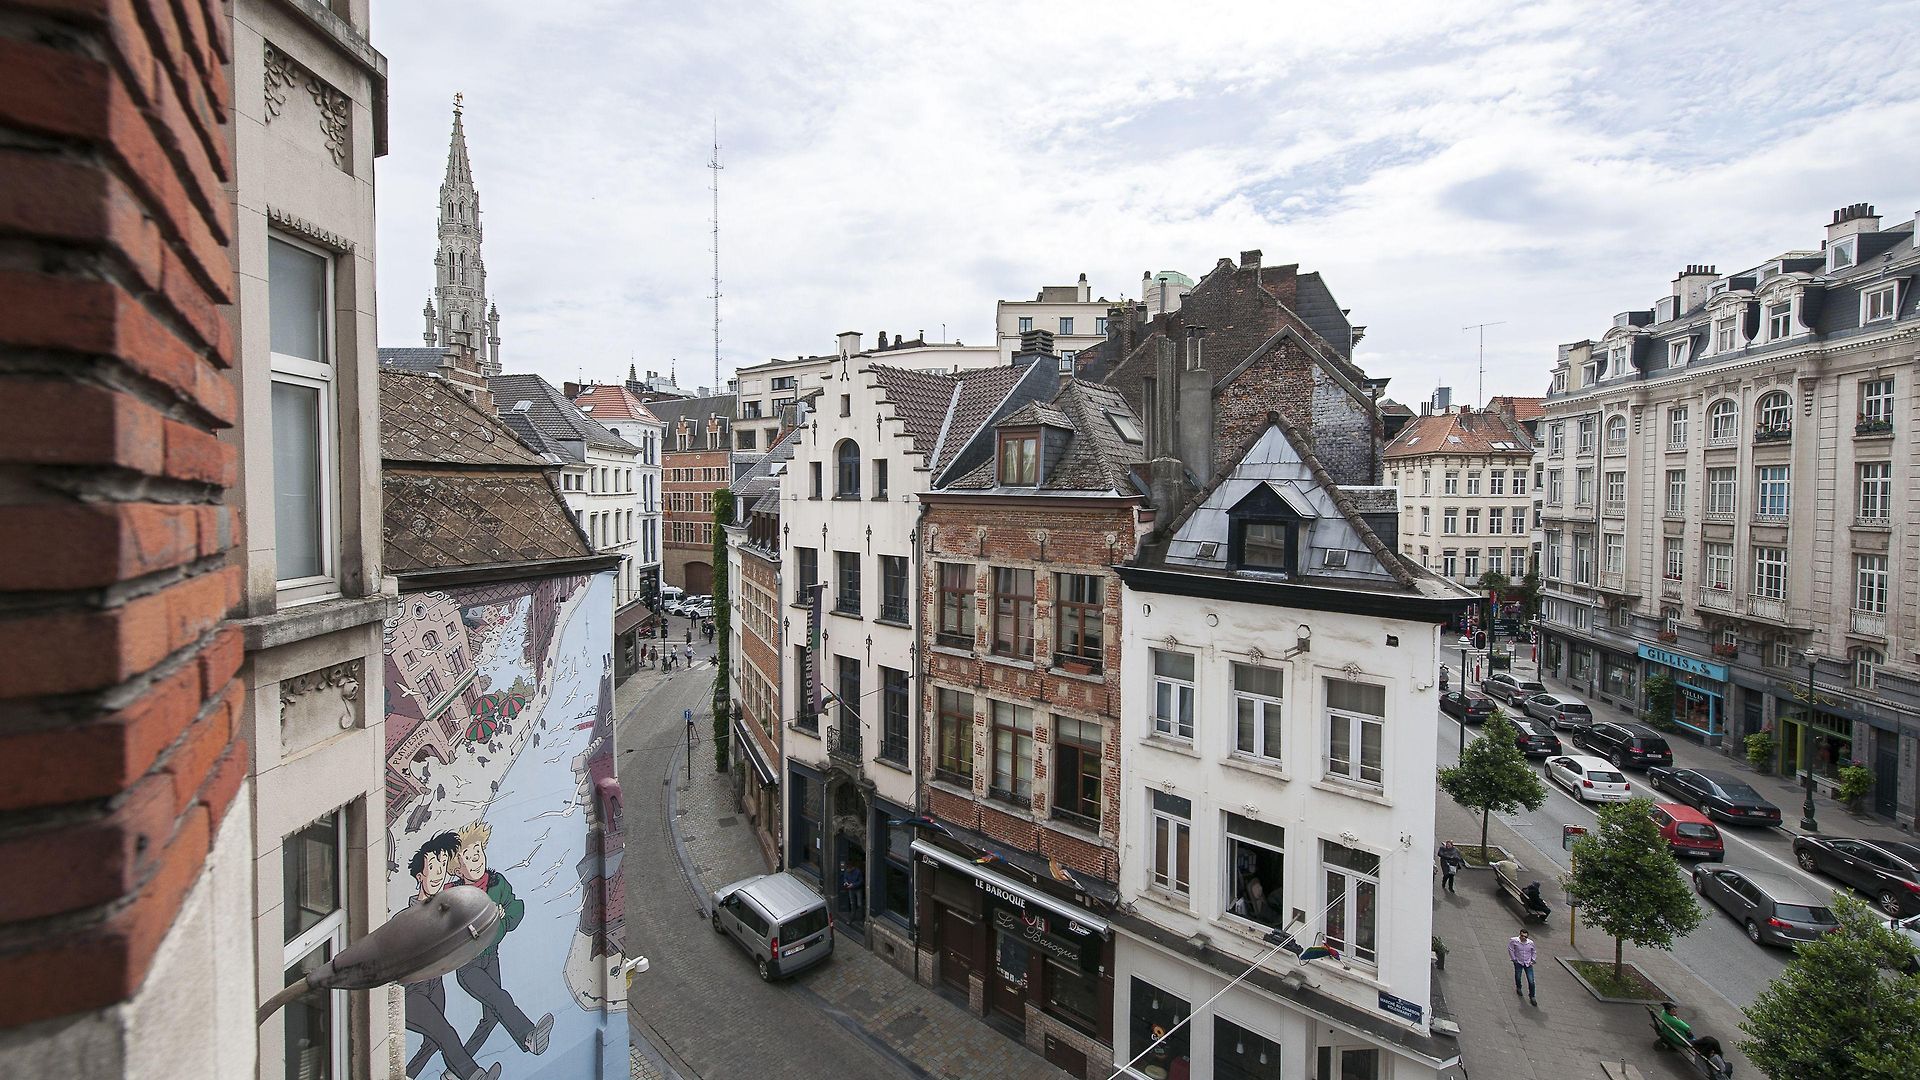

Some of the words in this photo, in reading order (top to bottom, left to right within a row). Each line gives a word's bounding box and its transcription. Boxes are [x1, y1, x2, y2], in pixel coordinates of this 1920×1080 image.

[806, 596, 815, 705] REGENBOOGHUIS
[1648, 649, 1689, 668] GILLIS
[1682, 690, 1704, 701] GILLIS
[392, 727, 430, 765] PLATTESTEEN
[975, 878, 984, 890] LE
[985, 880, 1027, 909] BAROQUE
[996, 911, 1015, 930] Le
[1023, 925, 1079, 961] Baroque
